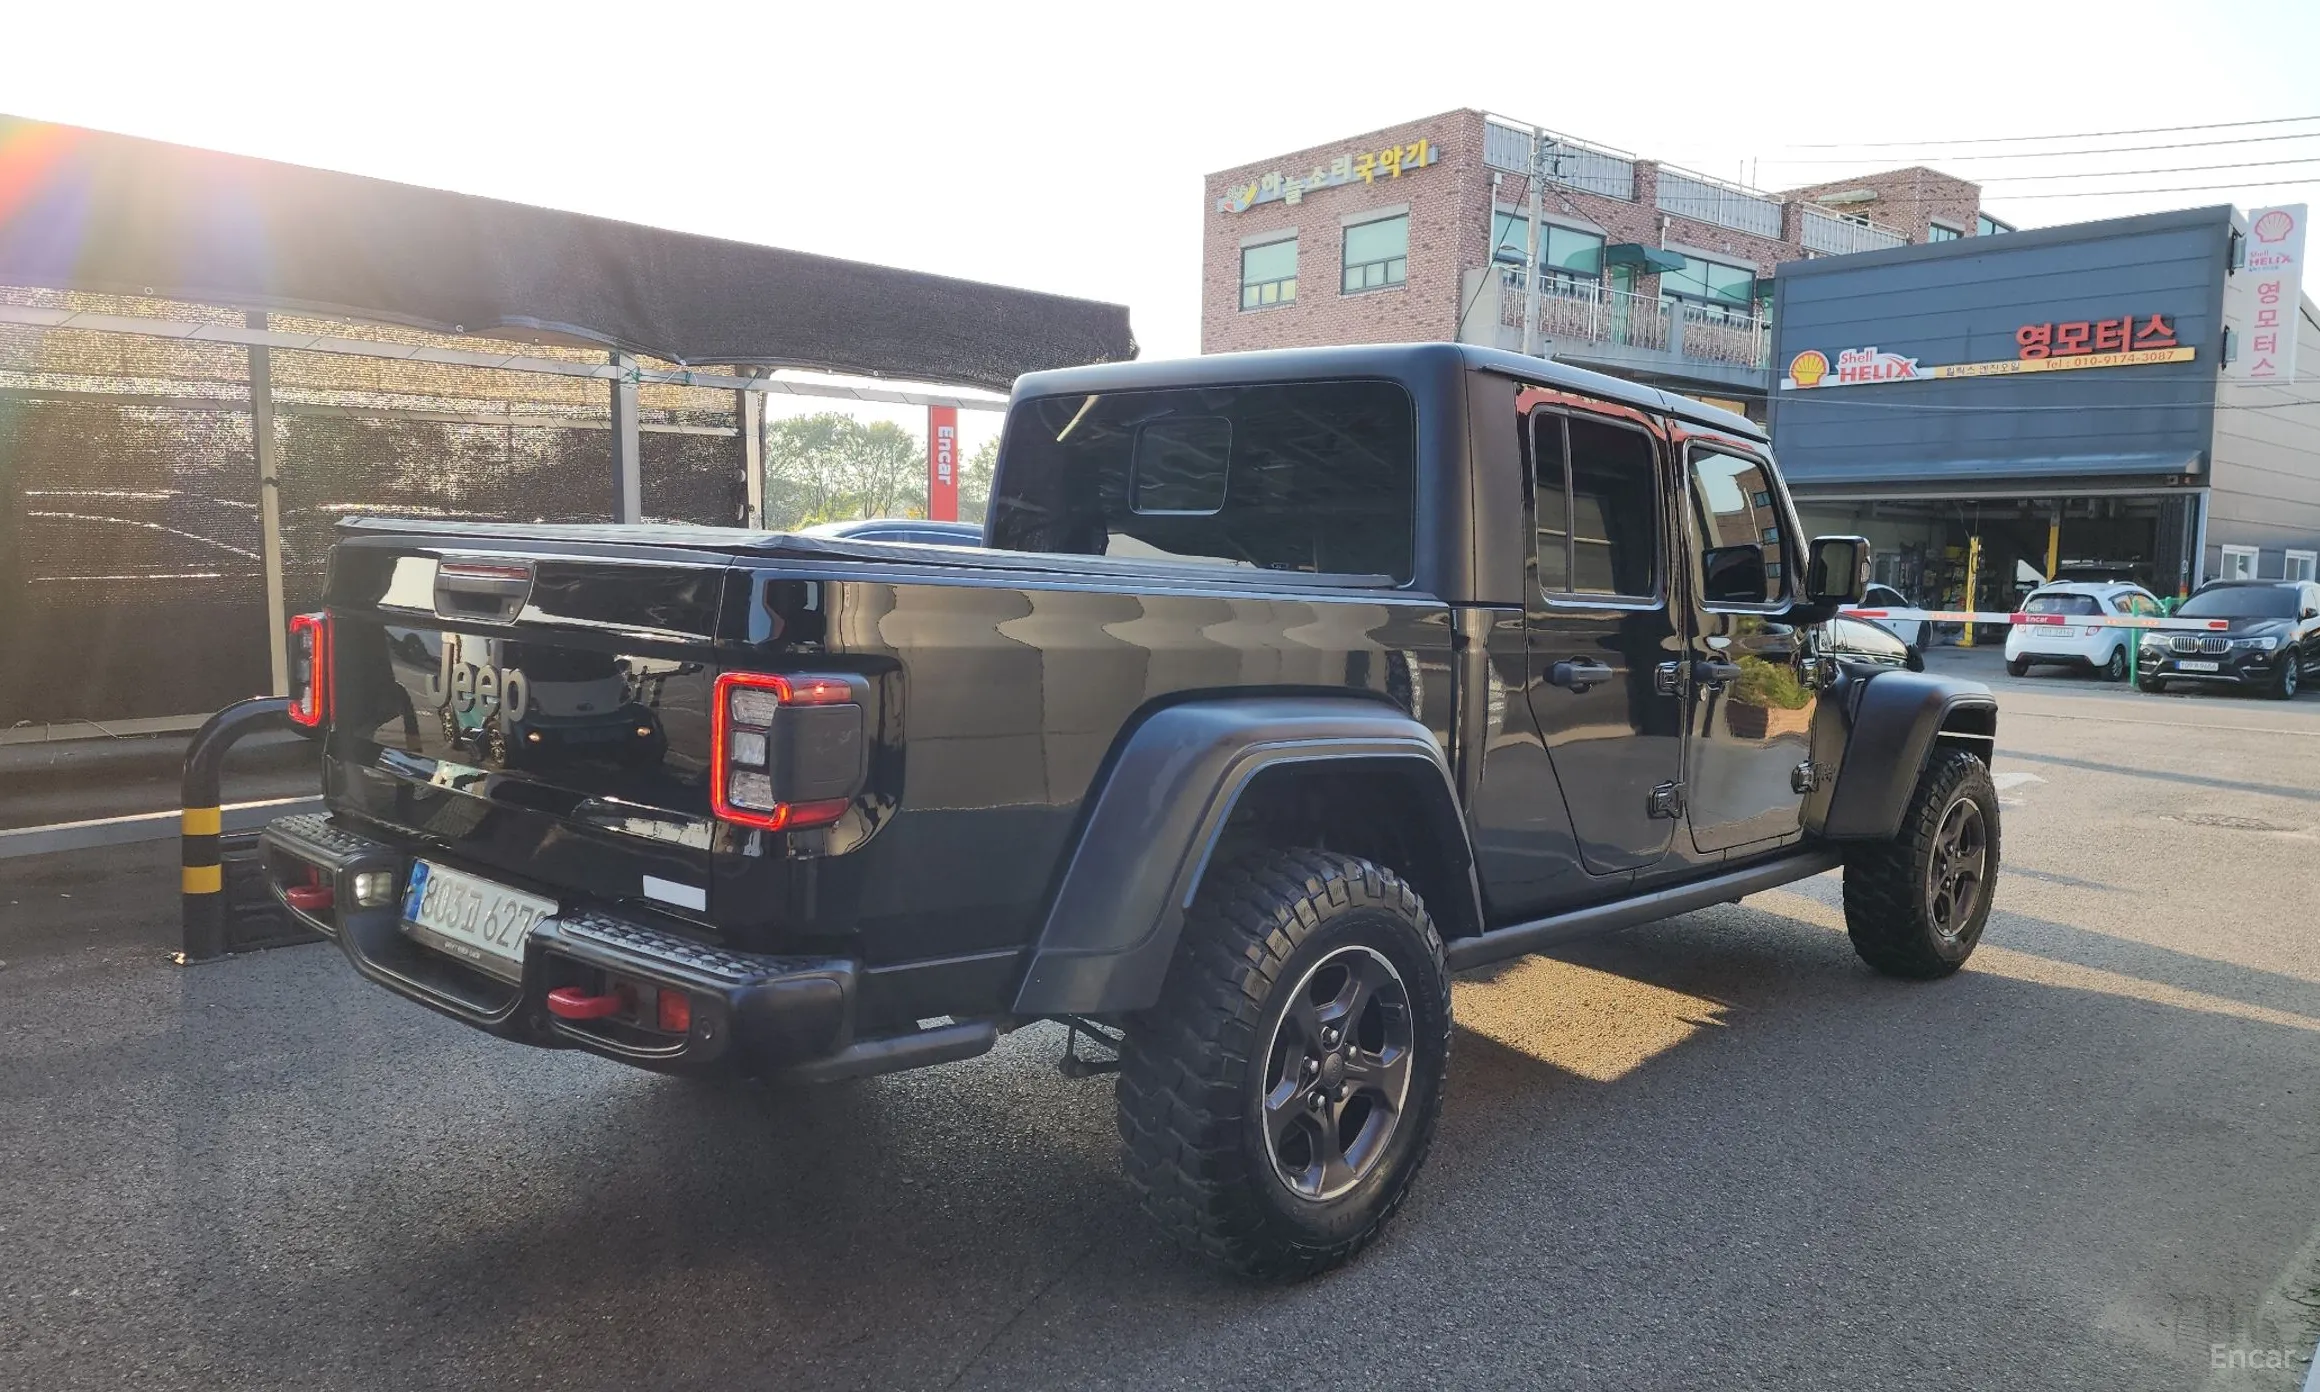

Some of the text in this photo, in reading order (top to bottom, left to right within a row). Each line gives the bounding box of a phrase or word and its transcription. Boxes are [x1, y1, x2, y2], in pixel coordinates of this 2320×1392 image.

[2016, 314, 2177, 359] 영모터스
[2251, 280, 2281, 378] 영모터스
[1840, 361, 1916, 382] HELIX
[1841, 350, 1873, 364] Shell
[2045, 359, 2062, 369] Tel
[2075, 350, 2175, 367] 010-9174-3087
[937, 426, 954, 486] Encar
[425, 632, 529, 735] Jeep
